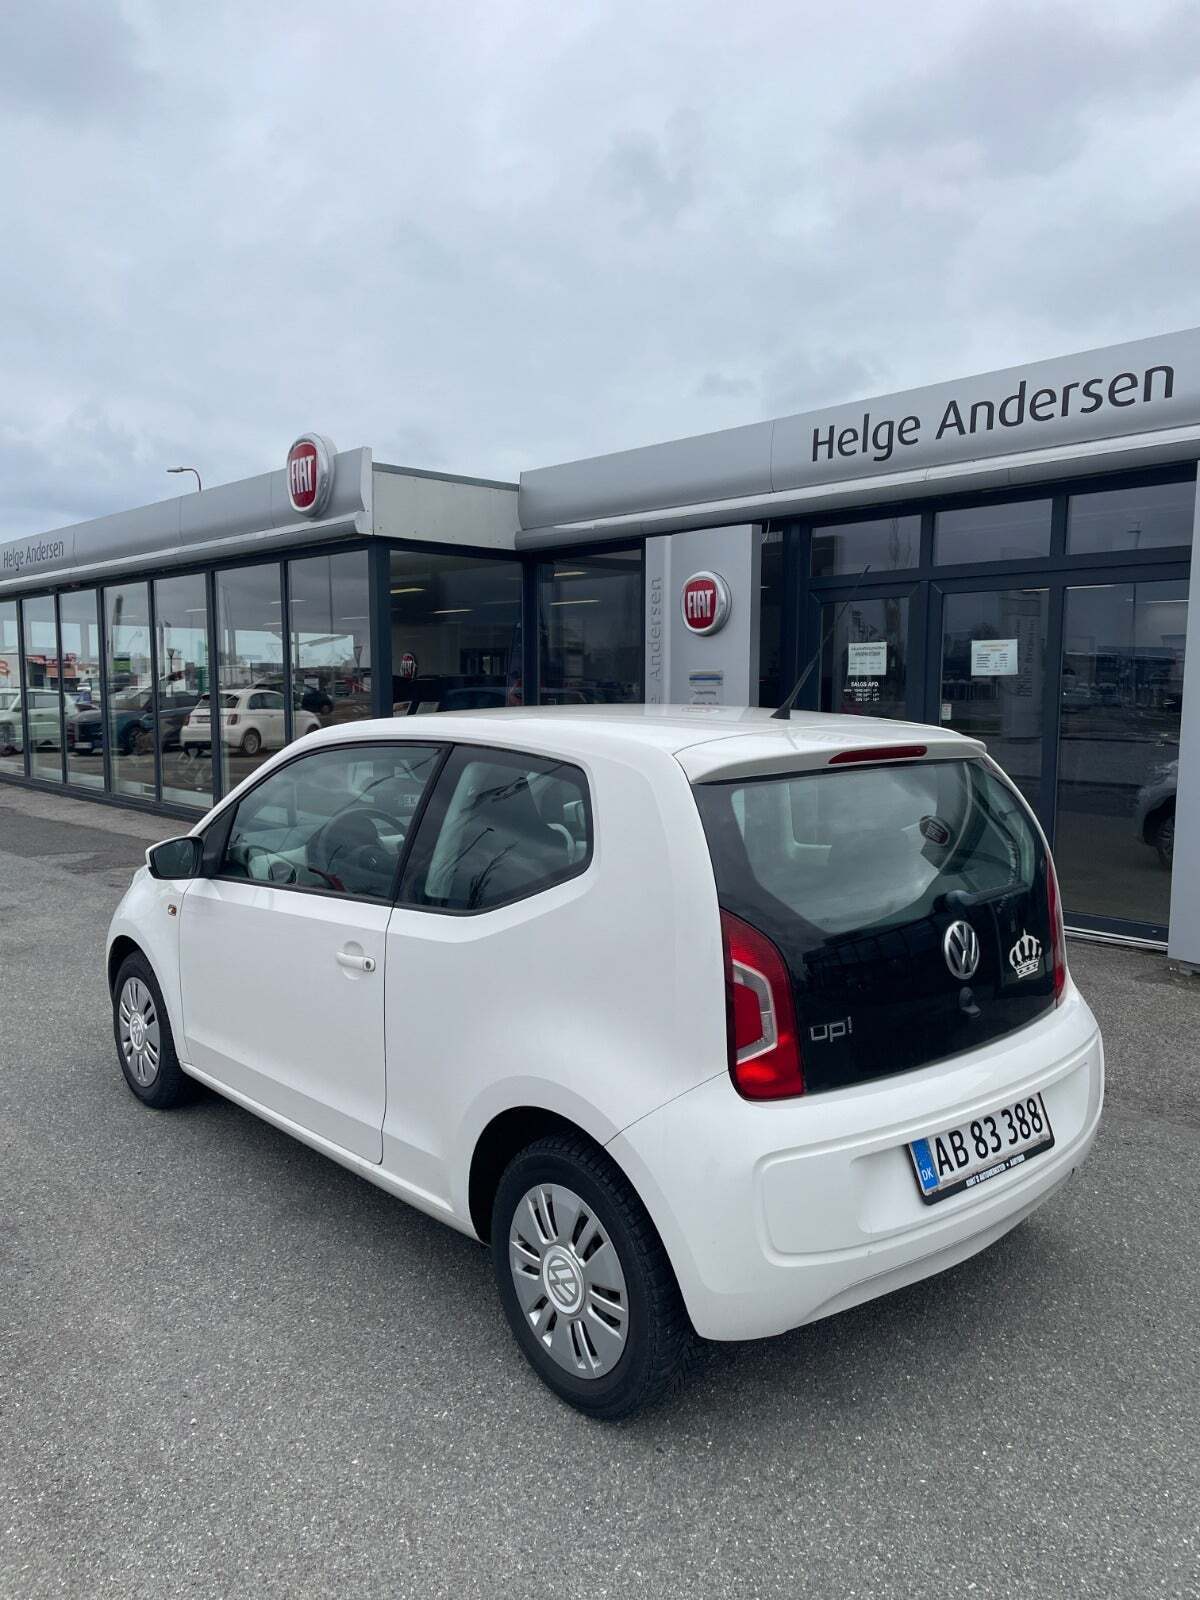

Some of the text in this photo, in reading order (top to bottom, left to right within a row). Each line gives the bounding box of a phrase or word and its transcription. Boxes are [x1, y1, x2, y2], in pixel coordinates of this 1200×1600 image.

[812, 365, 1174, 462] Helge Andersen
[291, 455, 315, 495] FIAT
[3, 540, 64, 571] Helge Andersen
[687, 589, 714, 619] FIAT
[648, 577, 662, 682] Andersen
[810, 1015, 853, 1042] up!
[934, 1130, 970, 1176] AB
[970, 1116, 1001, 1159] 83
[1001, 1098, 1043, 1145] 388
[921, 1167, 934, 1180] DK
